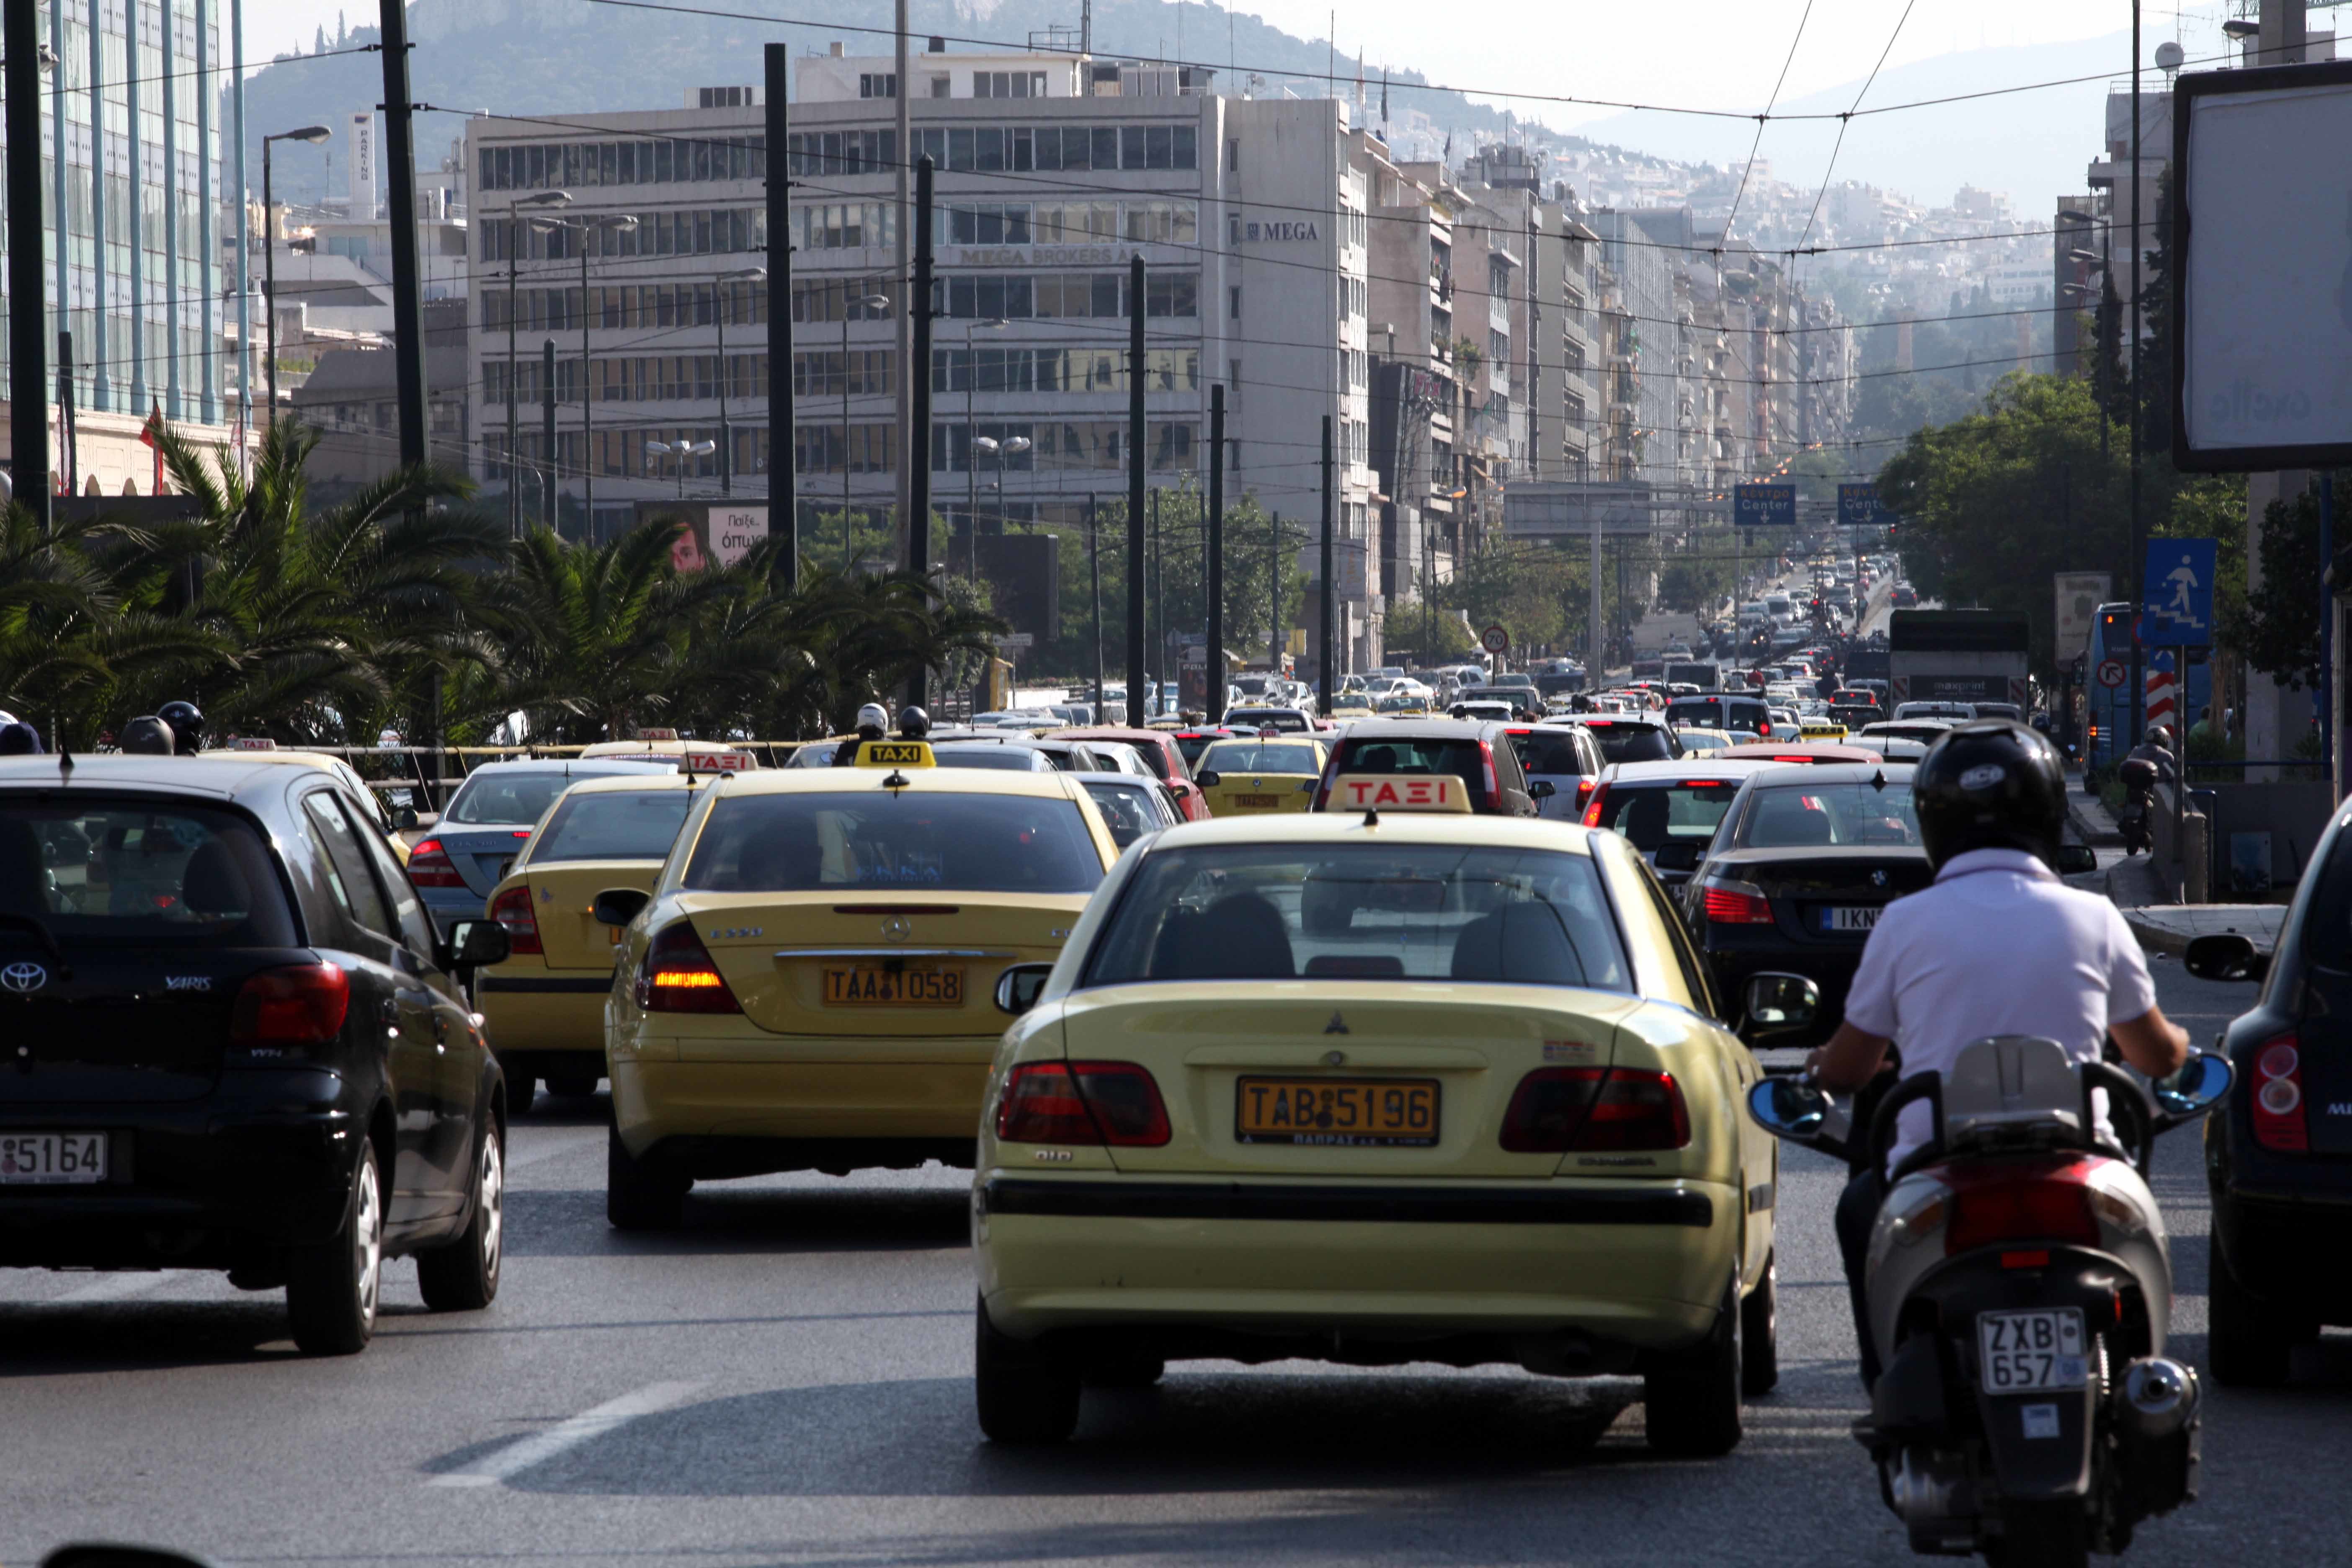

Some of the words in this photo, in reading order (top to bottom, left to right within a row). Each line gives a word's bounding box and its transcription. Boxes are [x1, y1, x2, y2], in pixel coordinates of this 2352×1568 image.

[1264, 222, 1317, 240] MEGA
[961, 250, 1025, 264] MEGA
[1033, 249, 1112, 263] BROKERS
[1741, 487, 1789, 500] Κέντρο
[1742, 499, 1789, 510] Center
[1488, 635, 1503, 645] 70
[1934, 681, 1985, 694] maxprint
[874, 748, 918, 761] TAXI
[690, 756, 746, 769] ΤΑΞΙ
[1348, 782, 1445, 804] ΤΑΞΙ
[165, 976, 212, 991] YARIS
[831, 972, 877, 999] TAA
[895, 972, 958, 1000] 1058
[1249, 1088, 1315, 1126] TAB
[1337, 1088, 1429, 1127] 5196
[18, 1138, 99, 1172] 5164
[1988, 1318, 2053, 1352] ZXB
[1994, 1354, 2053, 1386] 657
